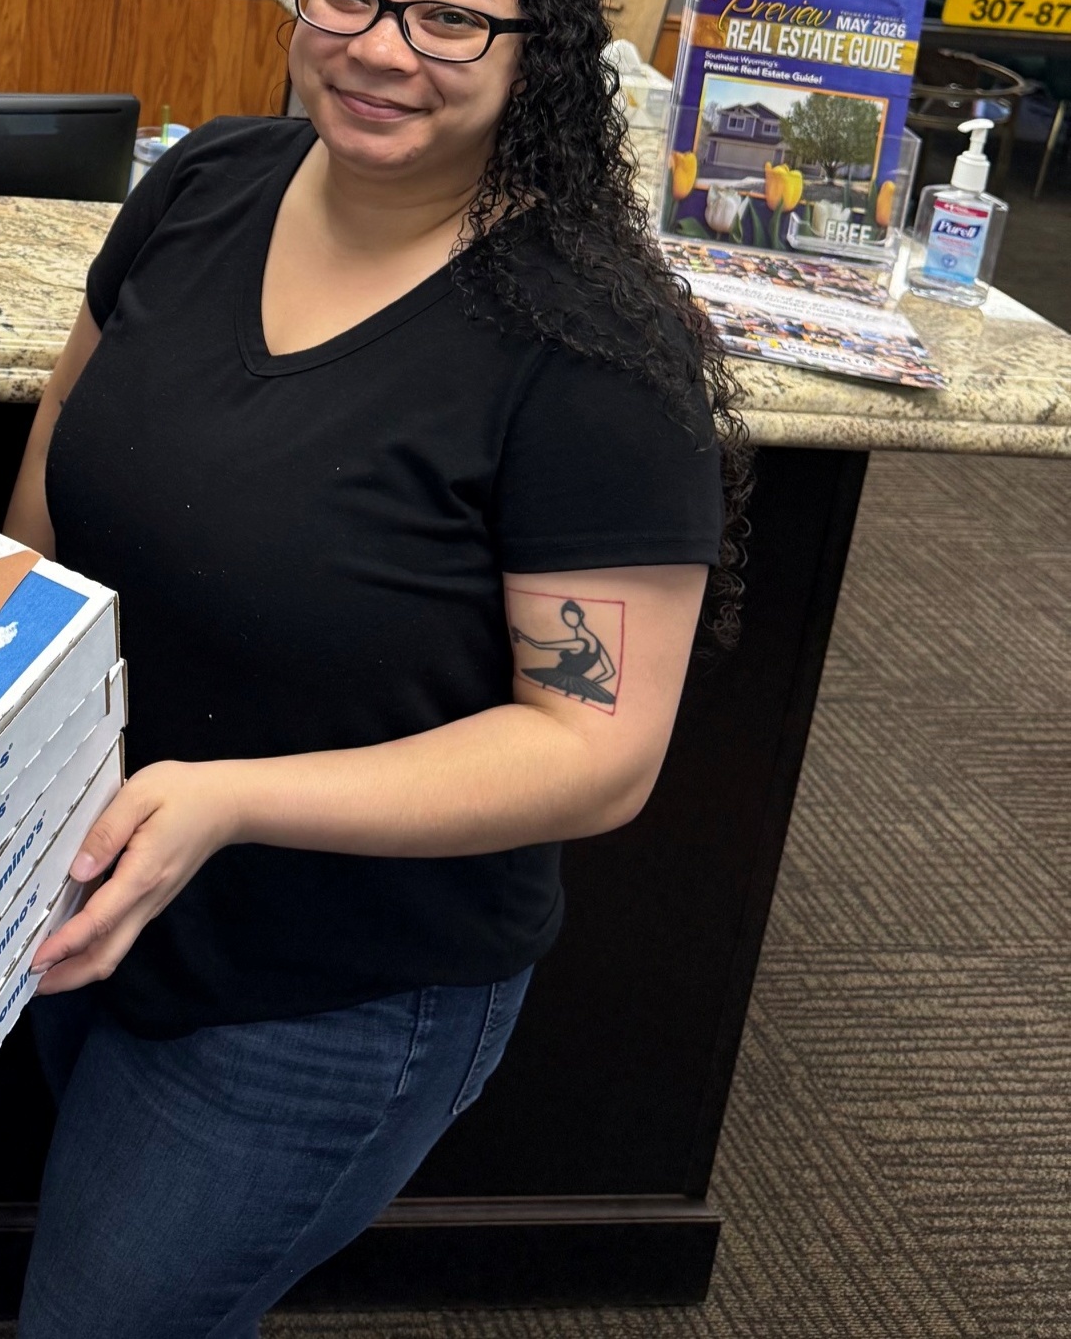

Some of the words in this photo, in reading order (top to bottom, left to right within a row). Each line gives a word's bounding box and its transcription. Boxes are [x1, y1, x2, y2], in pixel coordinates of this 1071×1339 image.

[836, 15, 870, 33] MAY
[872, 20, 907, 39] 2026
[705, 50, 739, 63] Southeast
[725, 19, 772, 54] REAL
[777, 25, 846, 63] ESTATE
[848, 36, 905, 72] GUIDE
[703, 59, 739, 73] Premier
[740, 64, 760, 76] Real
[761, 68, 790, 80] Estate
[791, 71, 823, 84] Guide!
[825, 219, 872, 246] FREE
[937, 220, 977, 239] Purell
